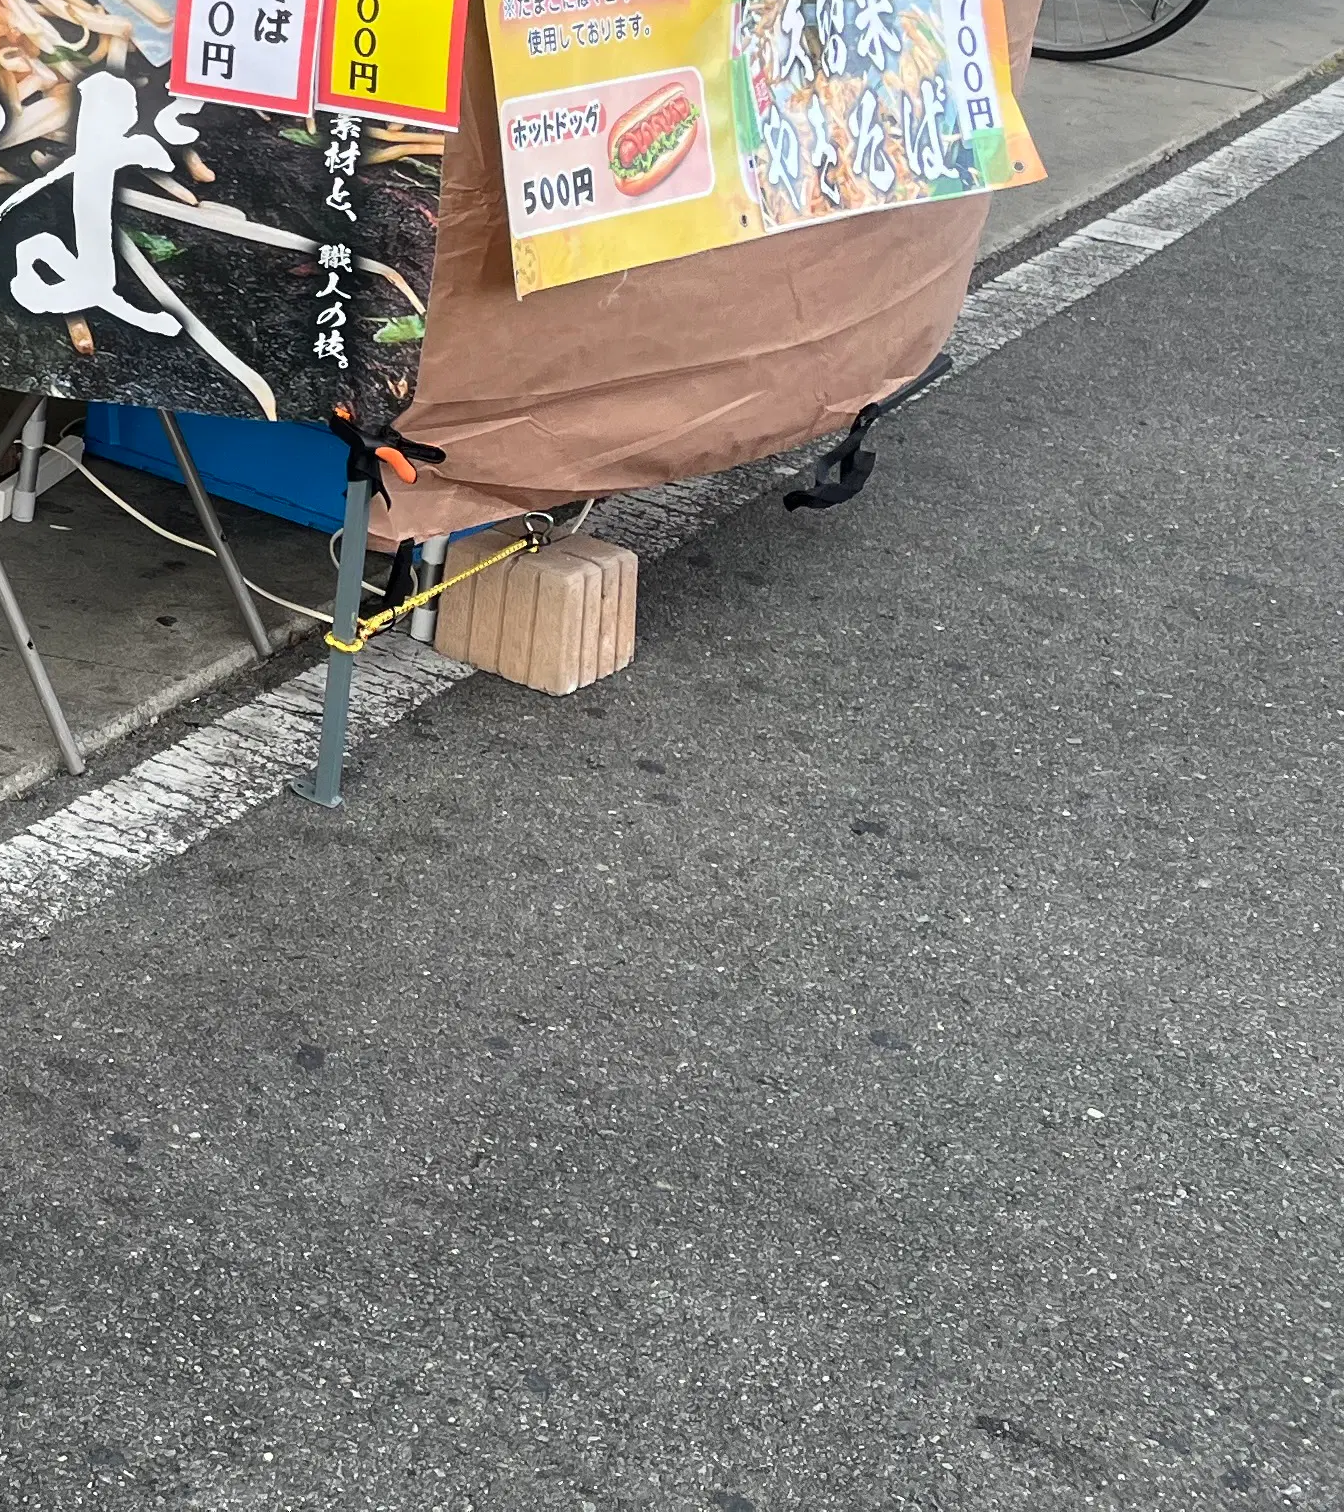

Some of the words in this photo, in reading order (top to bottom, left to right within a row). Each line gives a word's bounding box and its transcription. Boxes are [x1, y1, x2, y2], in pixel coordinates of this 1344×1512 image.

[528, 14, 650, 55] 使用しております。
[513, 102, 599, 149] ホットドッグ
[764, 77, 961, 211] やきそば
[523, 167, 594, 216] 500円
[313, 243, 352, 369] 職人の技。
